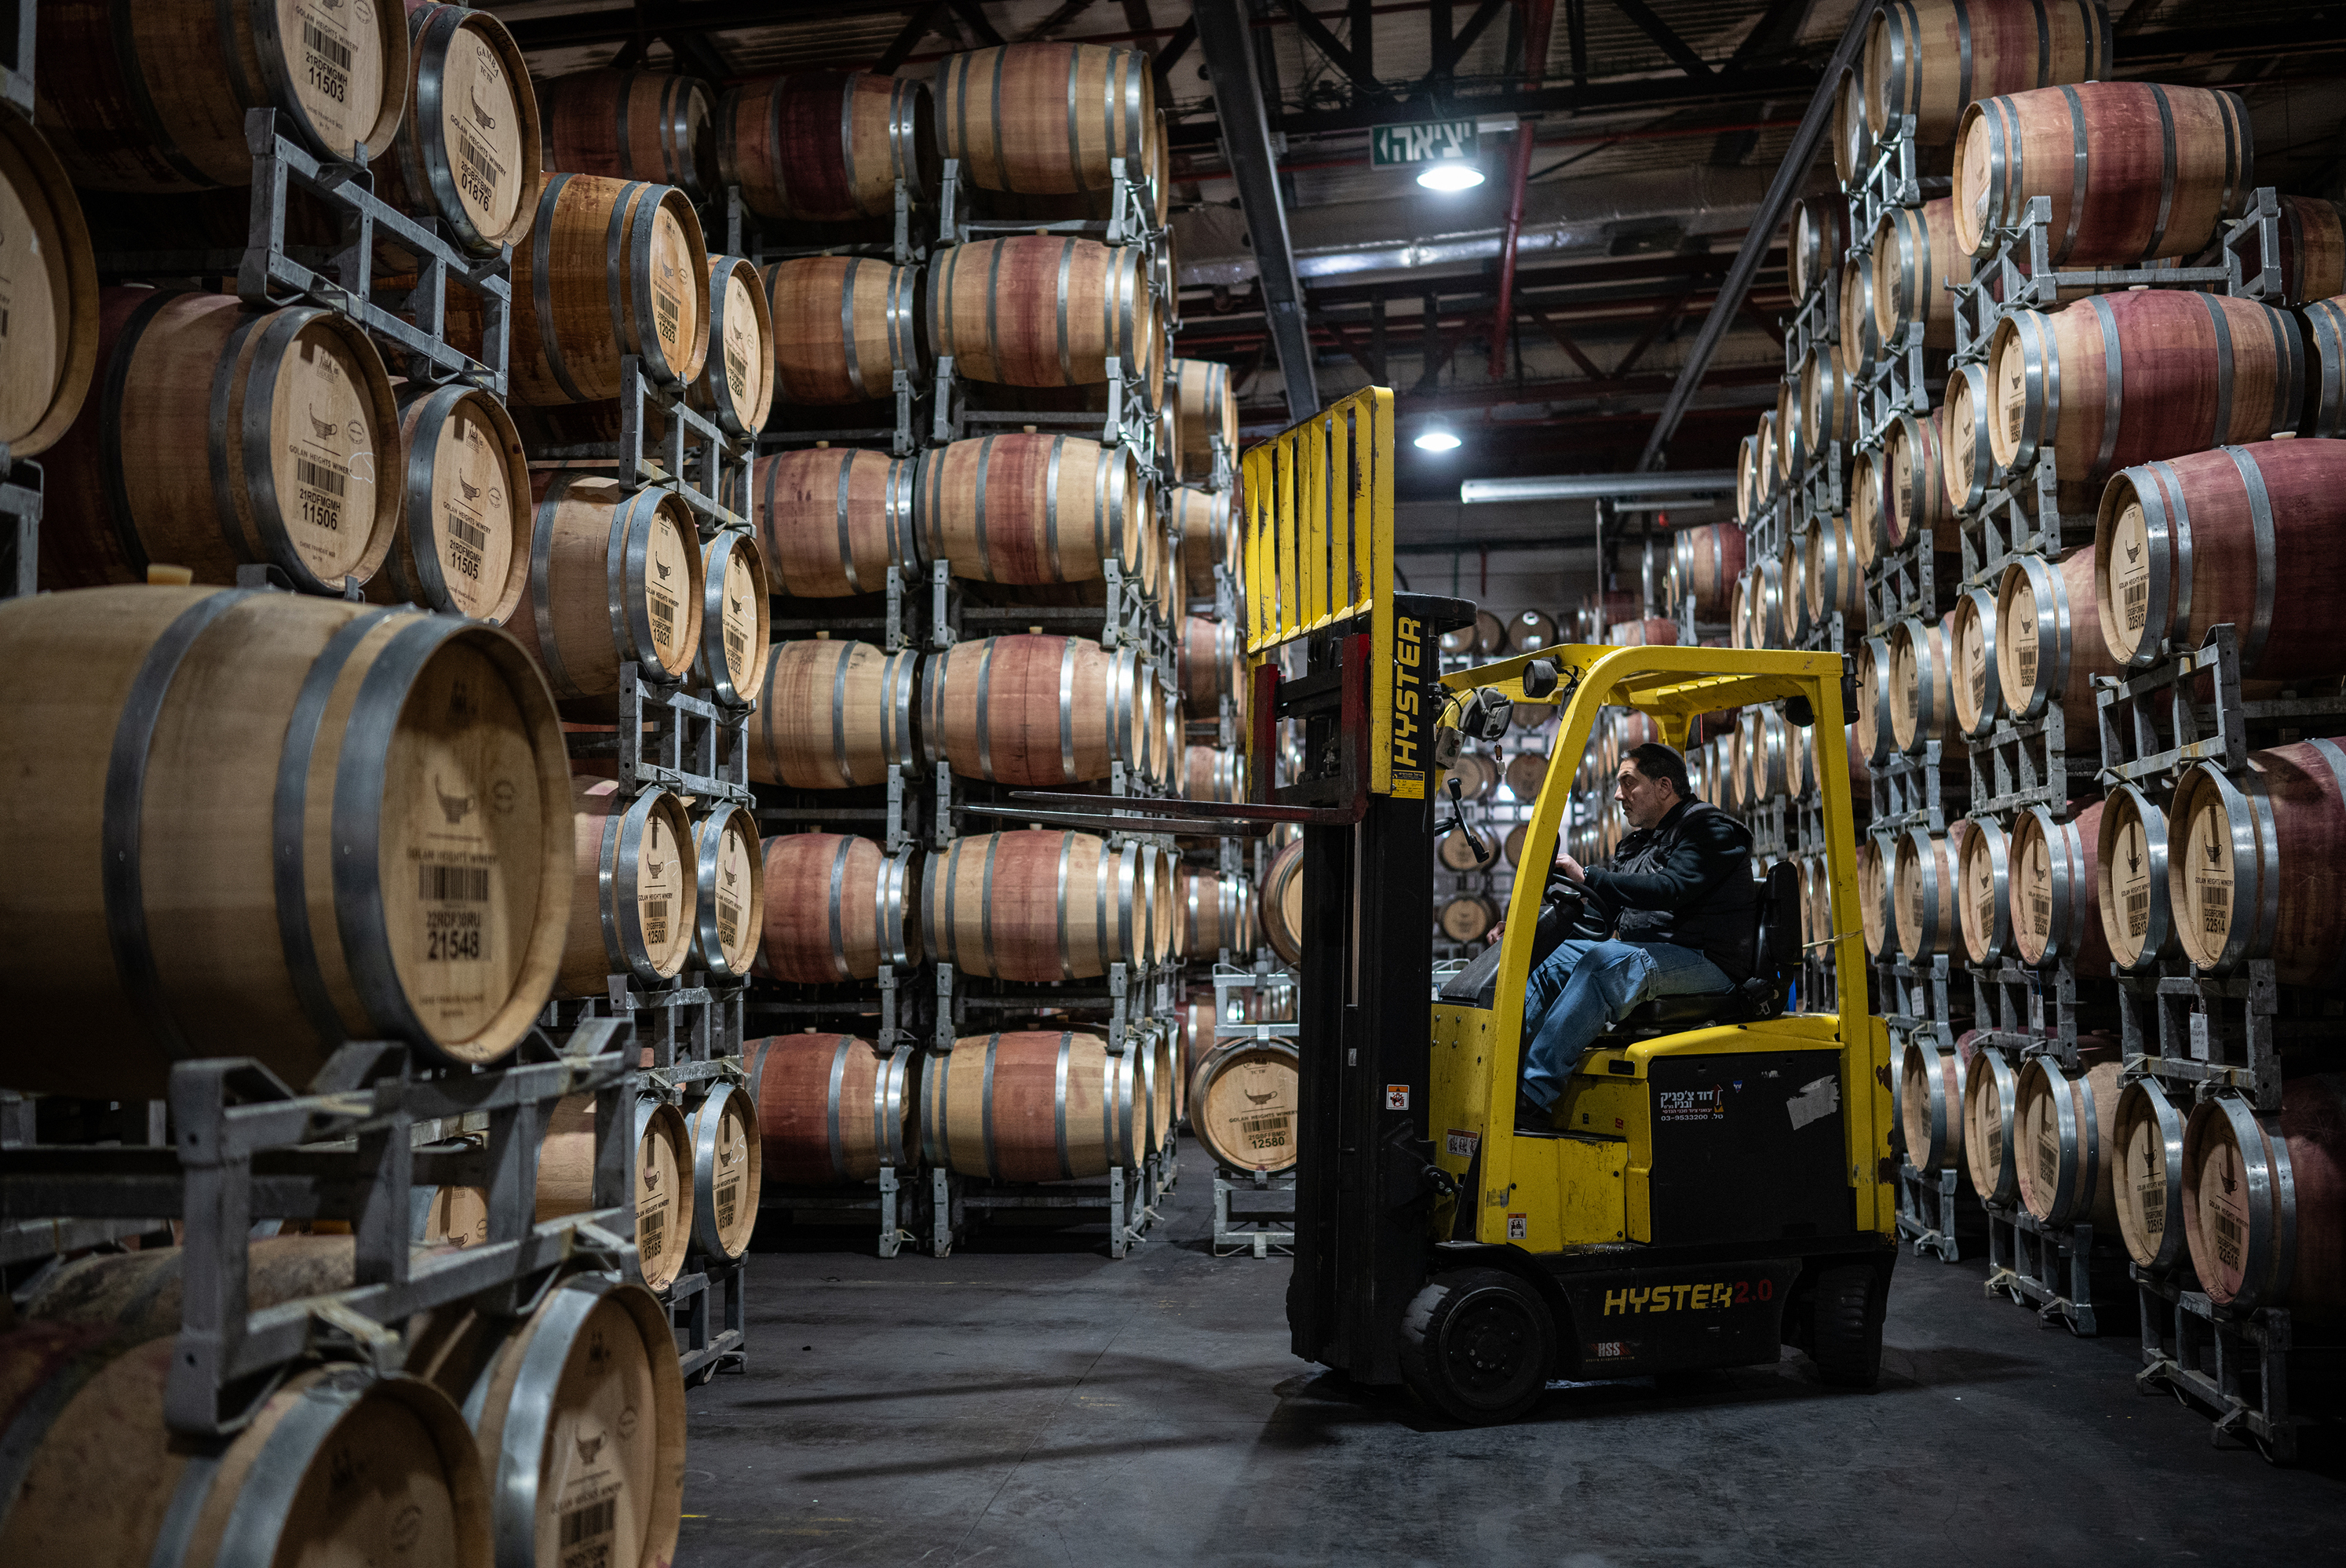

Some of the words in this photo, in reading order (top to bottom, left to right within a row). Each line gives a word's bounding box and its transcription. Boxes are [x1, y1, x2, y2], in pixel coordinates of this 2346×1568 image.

[295, 5, 315, 24] GOLAN
[316, 19, 337, 39] HEIGHTS
[338, 35, 359, 53] WINERY
[305, 52, 348, 86] 21RDFMGMH
[476, 46, 499, 77] GAMBA
[480, 65, 487, 76] TC
[487, 72, 493, 84] TH
[308, 67, 345, 104] 11503
[451, 115, 468, 135] GOLAN
[469, 133, 488, 158] HEIGHTS
[488, 154, 506, 177] WINERY
[1392, 122, 1472, 162] יציאה
[461, 161, 492, 199] 20GBFFBMD
[462, 173, 490, 212] 01876
[659, 321, 676, 344] 12923
[728, 376, 743, 399] 12924
[2011, 429, 2020, 443] 2250
[289, 444, 308, 458] GOLAN
[309, 452, 330, 468] HEIGHTS
[299, 488, 341, 513] 21RDFMGMH
[302, 501, 337, 531] 11506
[443, 501, 458, 514] GOLAN
[458, 509, 475, 525] HEIGHTS
[475, 520, 491, 534] WINERY
[450, 539, 481, 565] 21RDFMGMH
[451, 552, 479, 579] 11505
[2119, 581, 2129, 589] GOLAN
[2129, 576, 2140, 586] HEIGHTS
[2140, 573, 2150, 582] WINER
[655, 591, 668, 603] HEIGHTS
[668, 597, 679, 608] WINERY
[2129, 613, 2144, 631] 22512
[654, 628, 670, 647] 13021
[728, 656, 741, 676] 13022
[1394, 616, 1421, 768] HYSTER
[2122, 888, 2130, 898] GOLAN
[2130, 884, 2142, 895] HEIGHTS
[2206, 877, 2220, 886] HEIGHTS
[2132, 921, 2147, 937] 22513
[2206, 917, 2225, 934] 22514
[428, 930, 480, 961] 21548
[648, 929, 665, 944] 12500
[721, 930, 735, 947] 12499
[1675, 1100, 1692, 1109] ובניו
[1697, 1090, 1714, 1100] דוד
[1248, 1130, 1286, 1141] 21GBFFBMD
[1251, 1136, 1286, 1149] 12580
[721, 1179, 731, 1188] HEIGHTS
[2147, 1181, 2158, 1190] HEIGHTS
[645, 1204, 658, 1215] HEIGHTS
[658, 1198, 670, 1209] WINERY
[2209, 1199, 2220, 1210] GOLAN
[2221, 1205, 2235, 1221] HEIGHTS
[720, 1212, 734, 1230] 13186
[2147, 1218, 2163, 1233] 22515
[644, 1240, 662, 1261] 13185
[2219, 1245, 2238, 1271] 22516
[1604, 1282, 1733, 1317] HYSTER
[1734, 1279, 1773, 1304] 2.0
[1598, 1342, 1621, 1358] HSS
